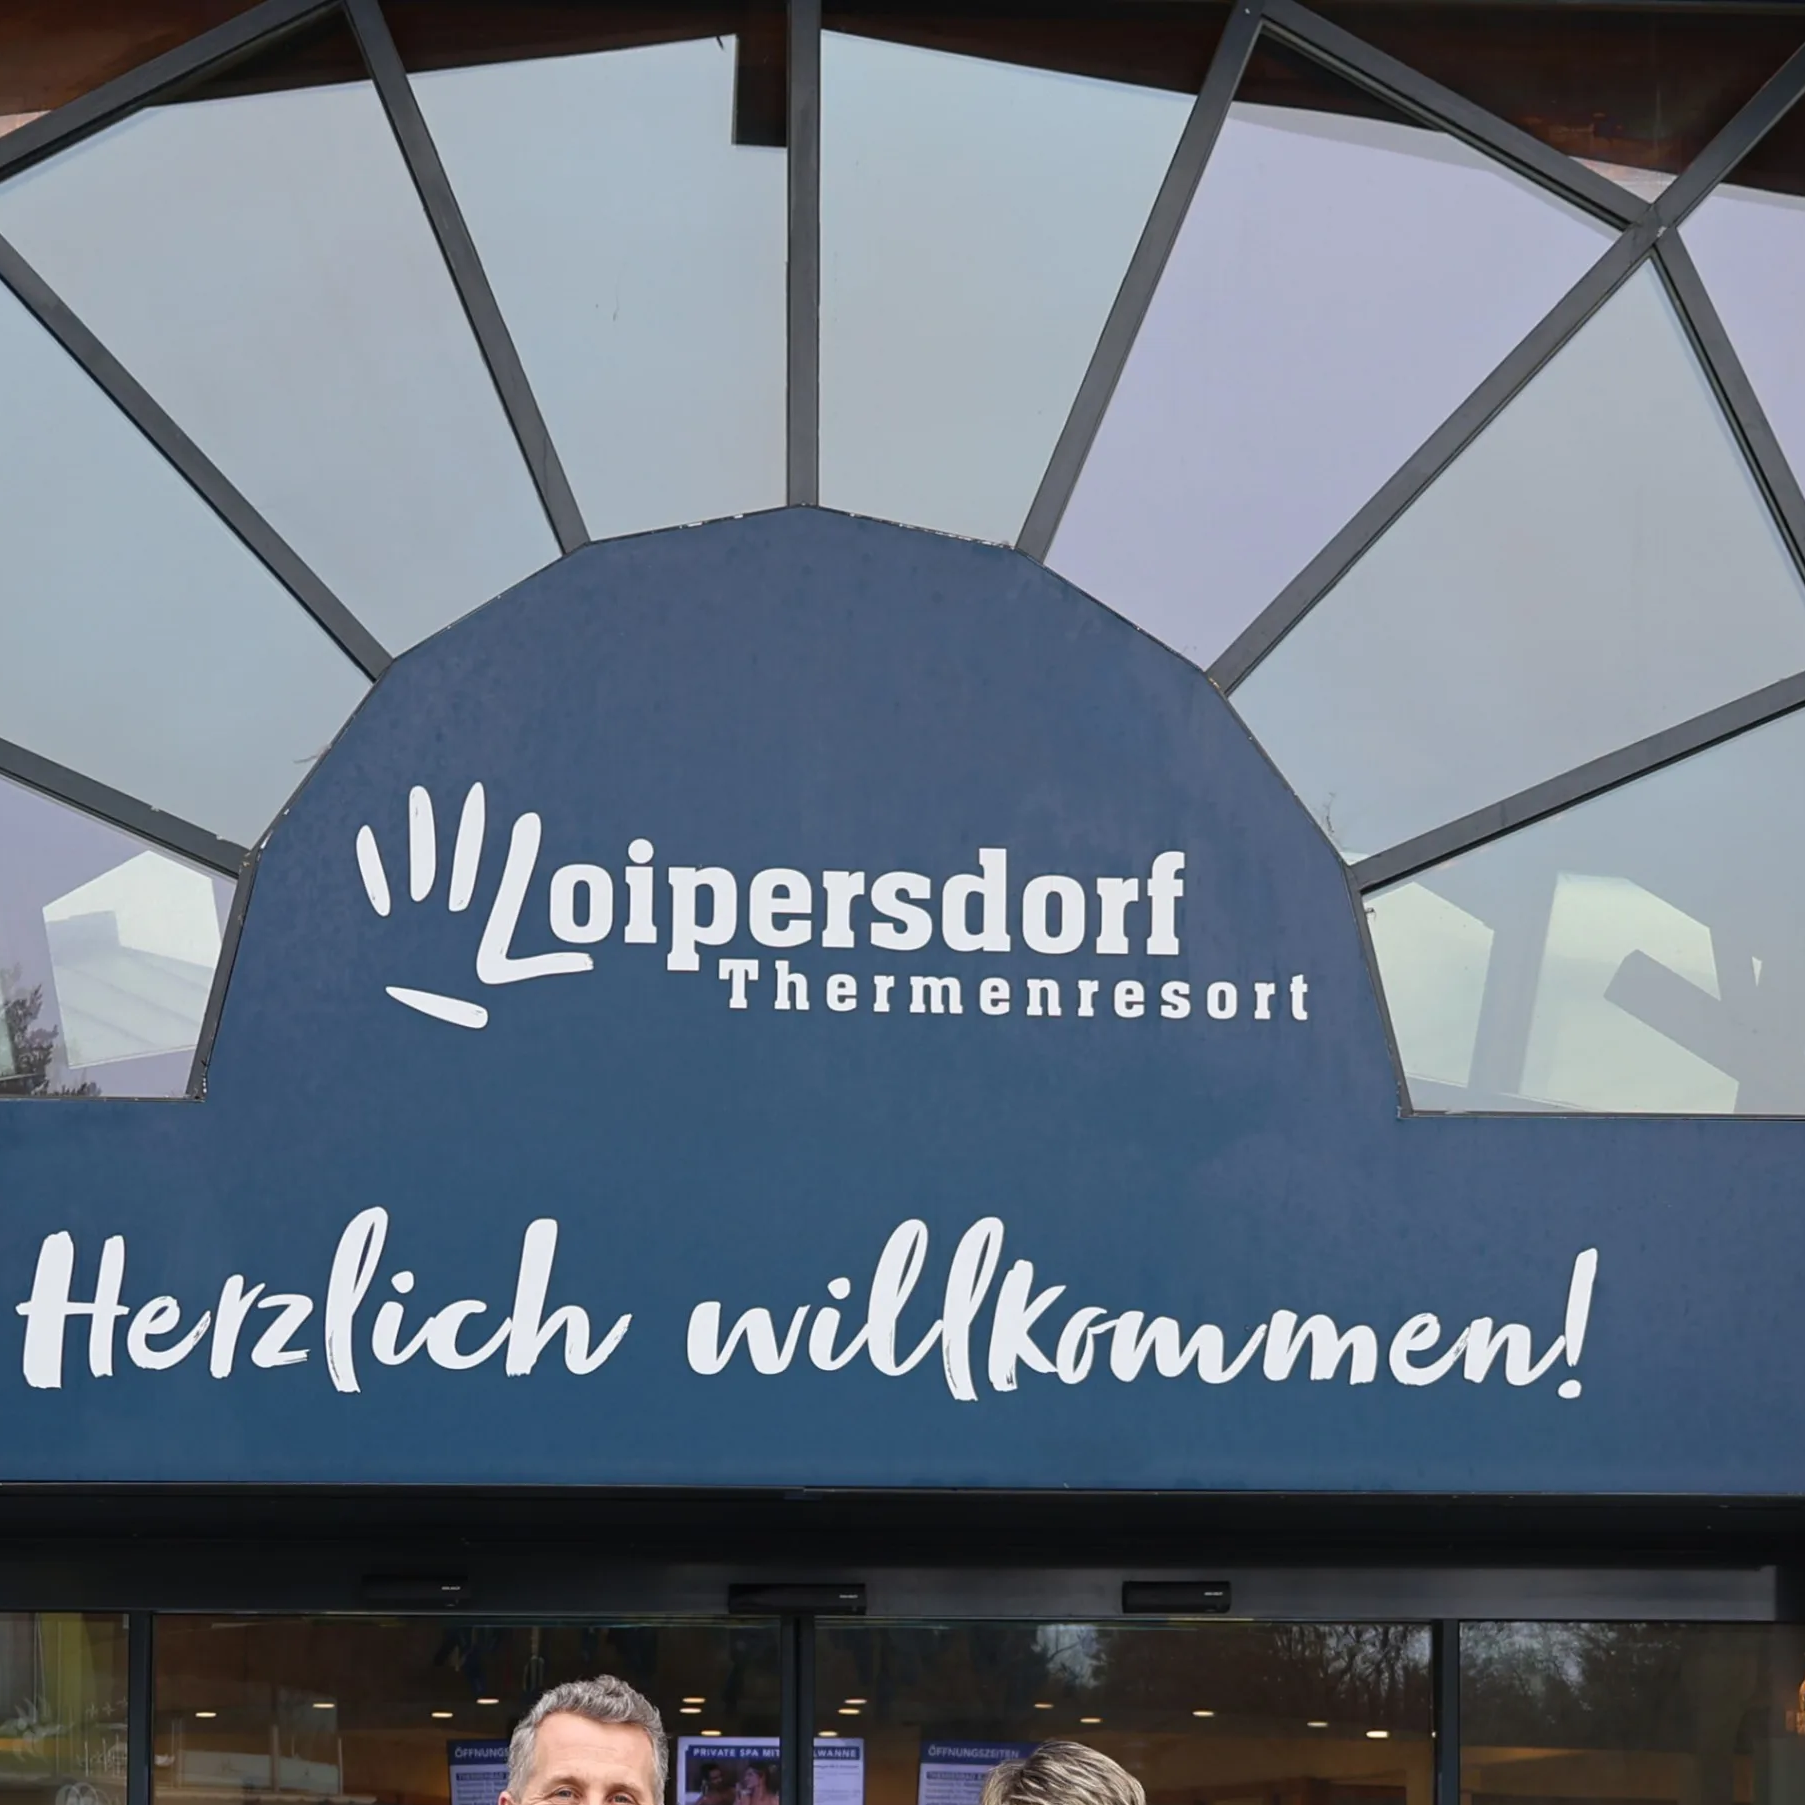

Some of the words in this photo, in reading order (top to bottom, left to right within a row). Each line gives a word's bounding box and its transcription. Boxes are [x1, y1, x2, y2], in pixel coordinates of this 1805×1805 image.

[477, 811, 1186, 985] Loipersdorf
[718, 957, 1309, 1022] Thermenresort
[16, 1205, 633, 1394] Herzlich
[686, 1215, 1599, 1401] willkommen!
[692, 1748, 736, 1758] PRIVATE
[739, 1748, 760, 1758] SPA
[927, 1744, 1020, 1759] ÖFFNUNGSZEITEN
